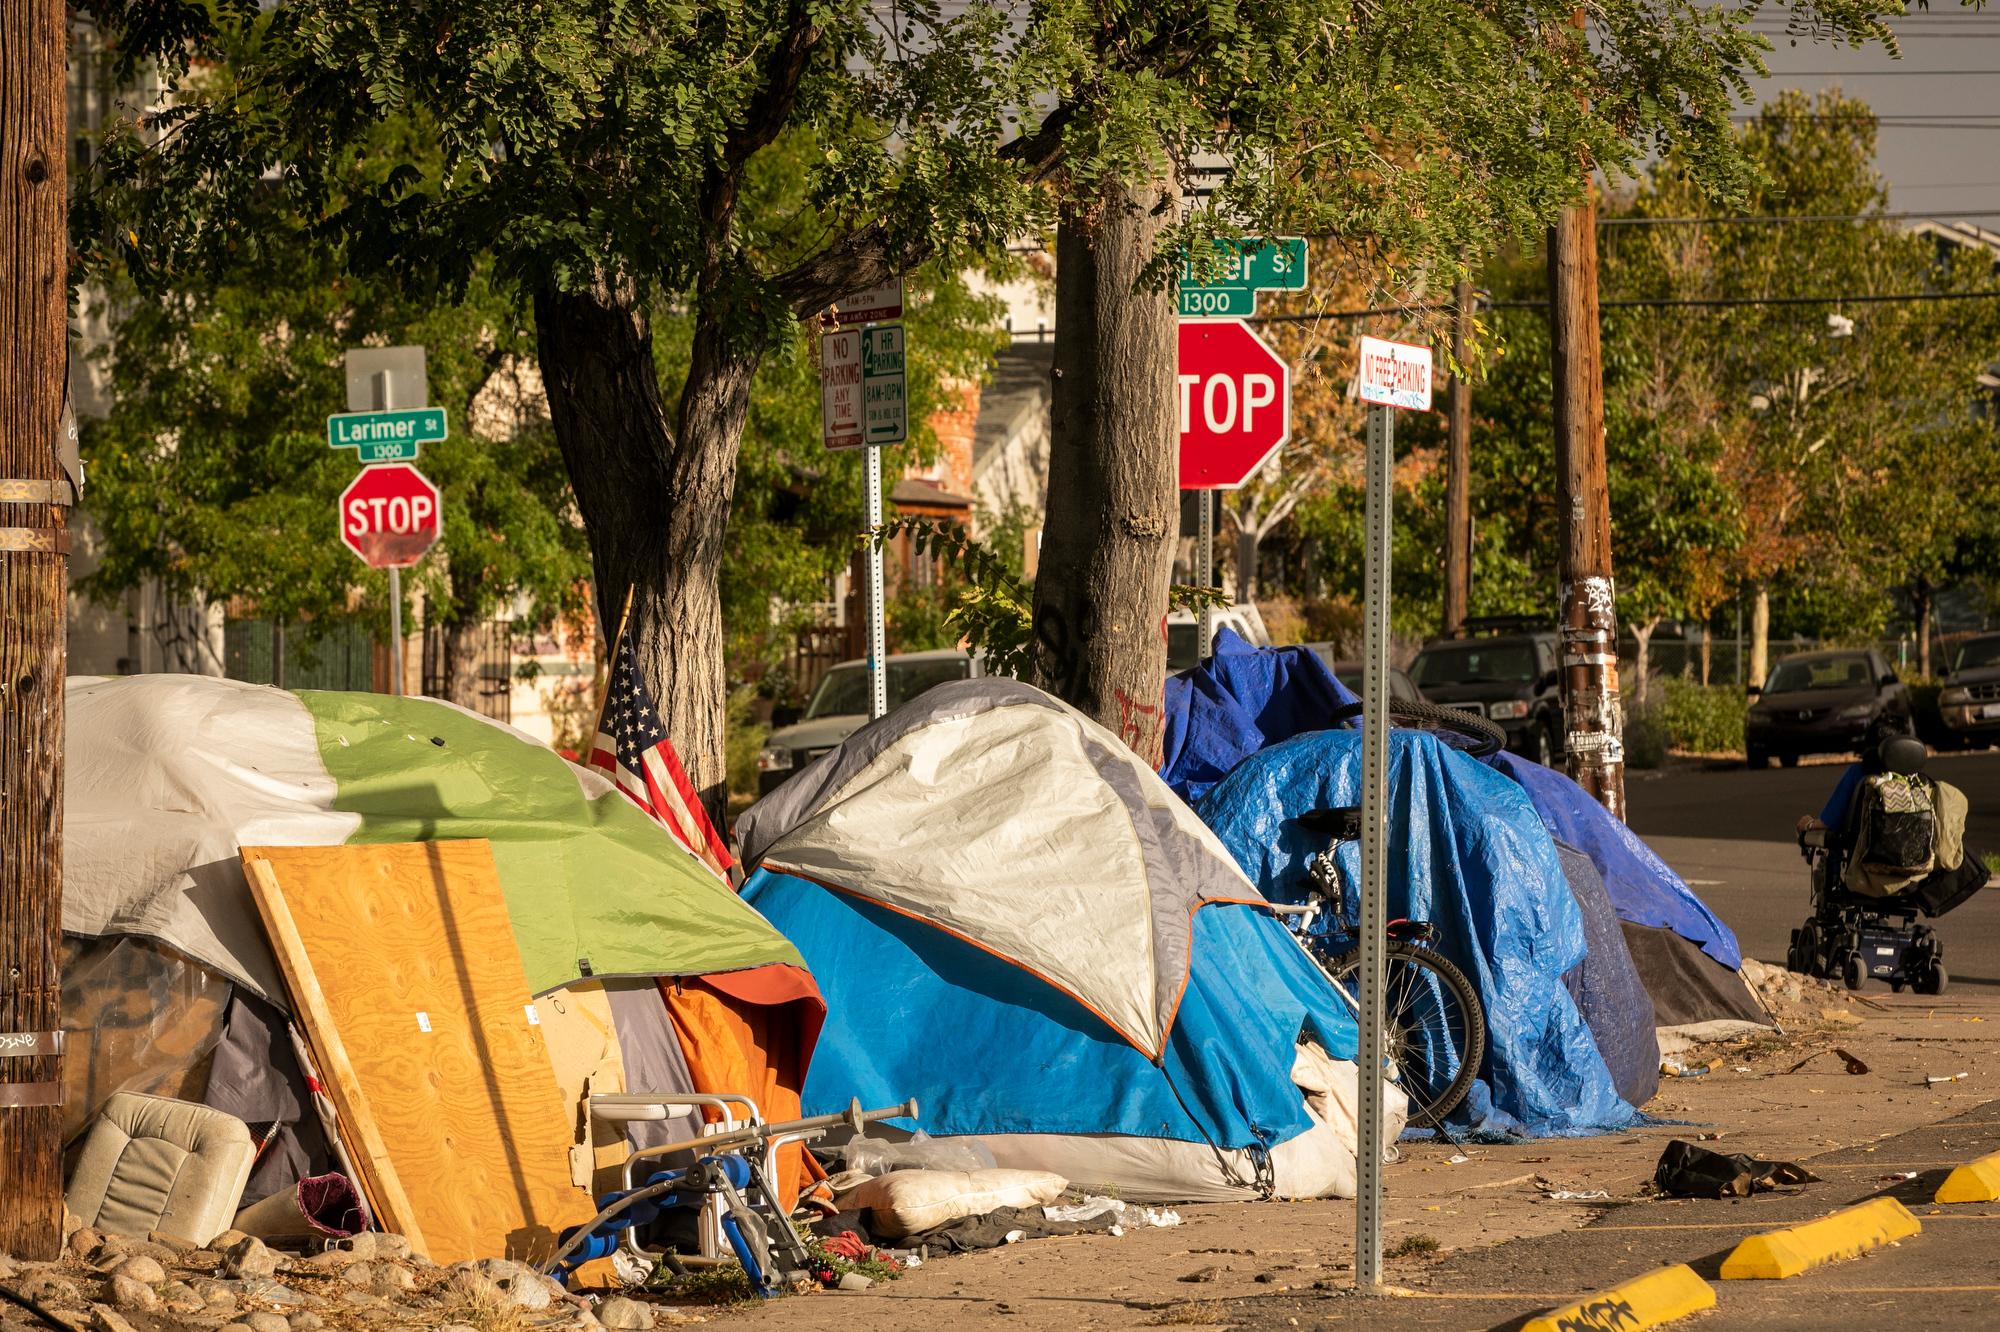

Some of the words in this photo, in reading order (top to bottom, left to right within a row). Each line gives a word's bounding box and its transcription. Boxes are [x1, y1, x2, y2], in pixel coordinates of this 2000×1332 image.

[1184, 293, 1230, 312] 1300
[870, 309, 888, 319] ZONE
[834, 337, 849, 359] NO
[864, 338, 873, 369] 2
[881, 332, 893, 350] HR
[873, 351, 902, 371] PARKING
[825, 363, 860, 387] PARKING
[1365, 353, 1374, 384] NO
[1375, 355, 1392, 388] FREE
[1393, 359, 1425, 394] PARKING
[835, 387, 850, 403] ANY
[867, 383, 902, 403] 8AM-10PM
[1179, 373, 1276, 434] TOP
[834, 403, 852, 419] TIME
[338, 418, 416, 442] Larimer
[424, 418, 437, 431] St
[374, 444, 403, 458] 1300
[348, 495, 433, 537] STOP
